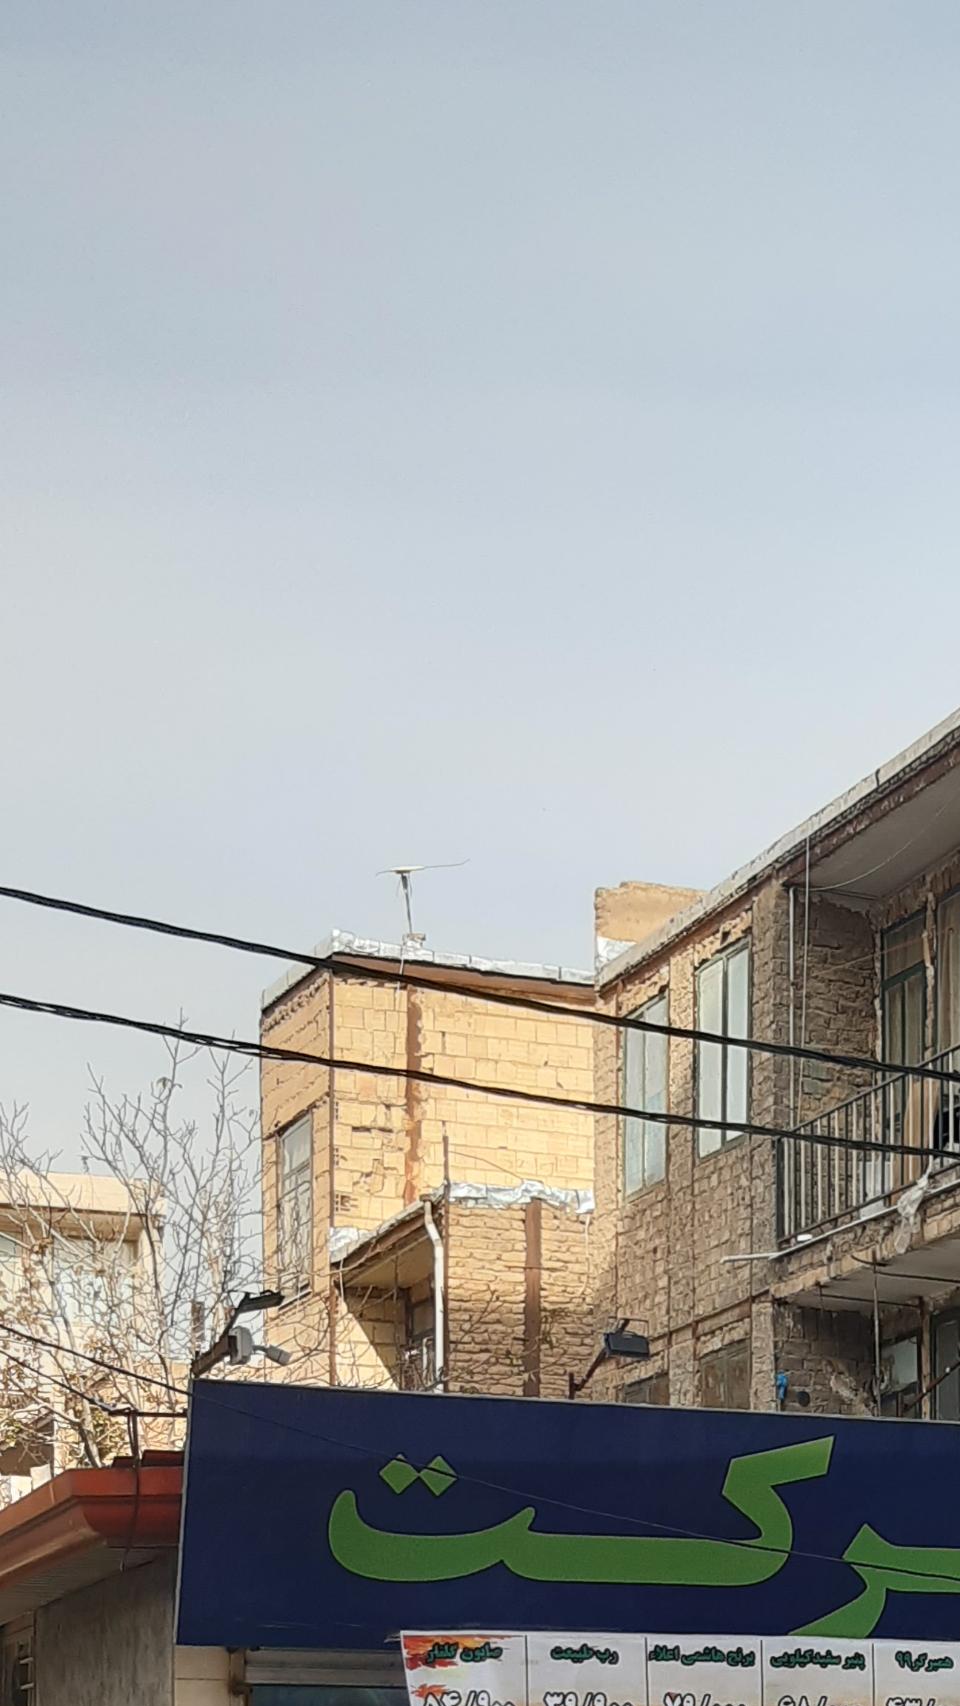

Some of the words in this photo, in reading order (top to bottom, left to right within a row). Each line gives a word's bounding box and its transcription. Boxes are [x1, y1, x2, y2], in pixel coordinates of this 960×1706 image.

[459, 1642, 503, 1662] صابون
[550, 1643, 596, 1664] طبیعت
[680, 1646, 726, 1666] هاشمی
[727, 1647, 755, 1667] برنج
[842, 1652, 866, 1671] پنیر
